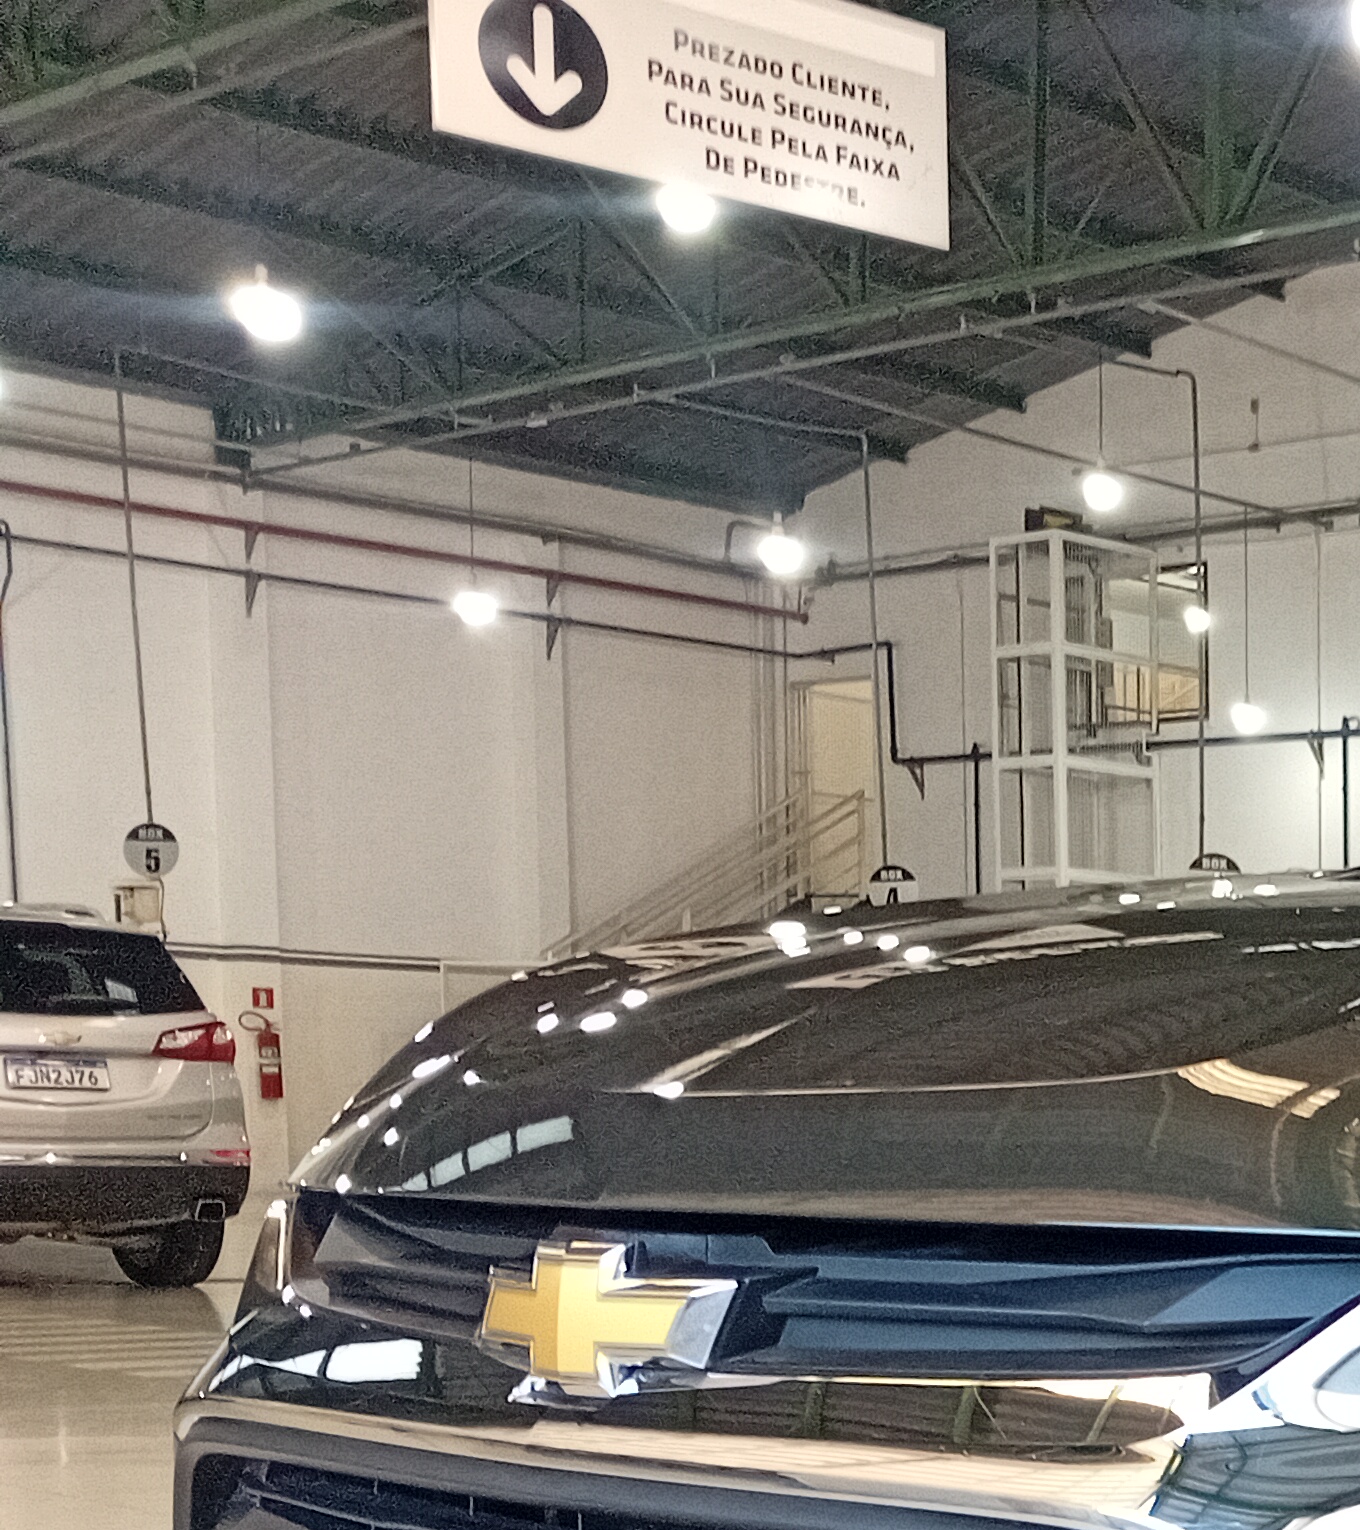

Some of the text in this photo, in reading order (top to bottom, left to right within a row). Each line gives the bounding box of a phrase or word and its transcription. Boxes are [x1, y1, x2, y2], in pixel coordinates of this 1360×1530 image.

[647, 58, 915, 153] PARA SUA SEGURANÇA,
[673, 28, 890, 111] PREZADO CLIENTE,
[665, 100, 901, 182] CIRCULE PELA FAIXA
[705, 146, 735, 176] DE
[145, 848, 160, 873] 5
